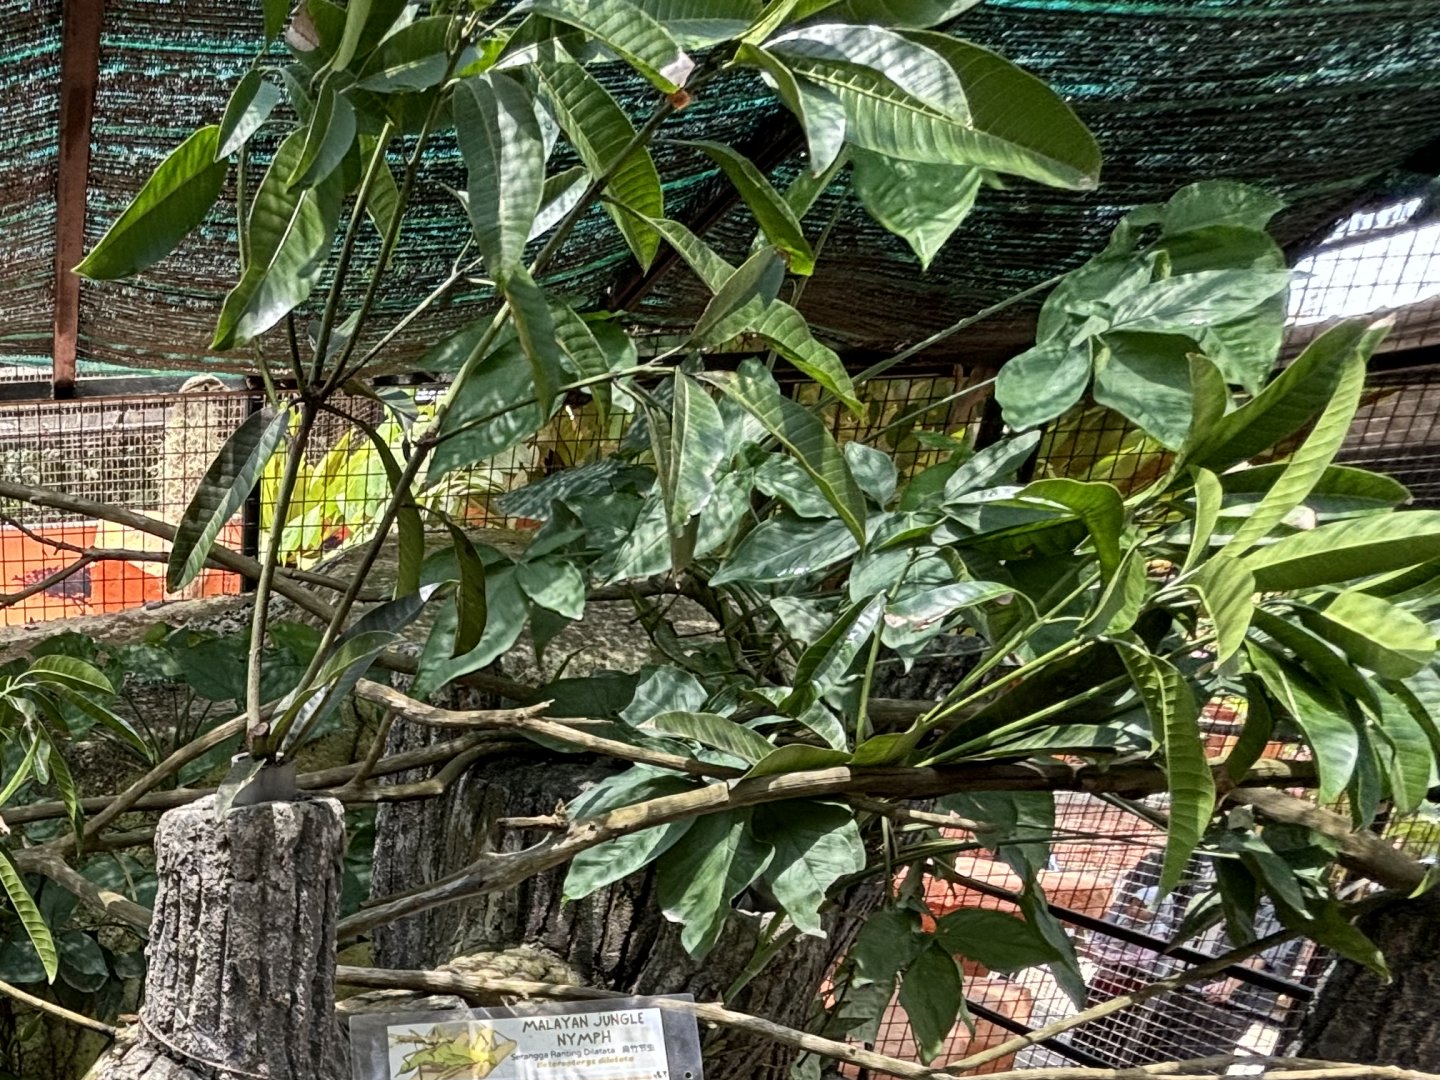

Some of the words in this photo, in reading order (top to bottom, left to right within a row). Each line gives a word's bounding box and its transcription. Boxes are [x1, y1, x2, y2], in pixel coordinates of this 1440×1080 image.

[522, 1015, 589, 1033] MALAYAN
[593, 1011, 645, 1028] JUNGLE
[557, 1029, 612, 1047] NYMPH
[510, 1050, 549, 1061] Serangga
[550, 1049, 583, 1060] Ranting
